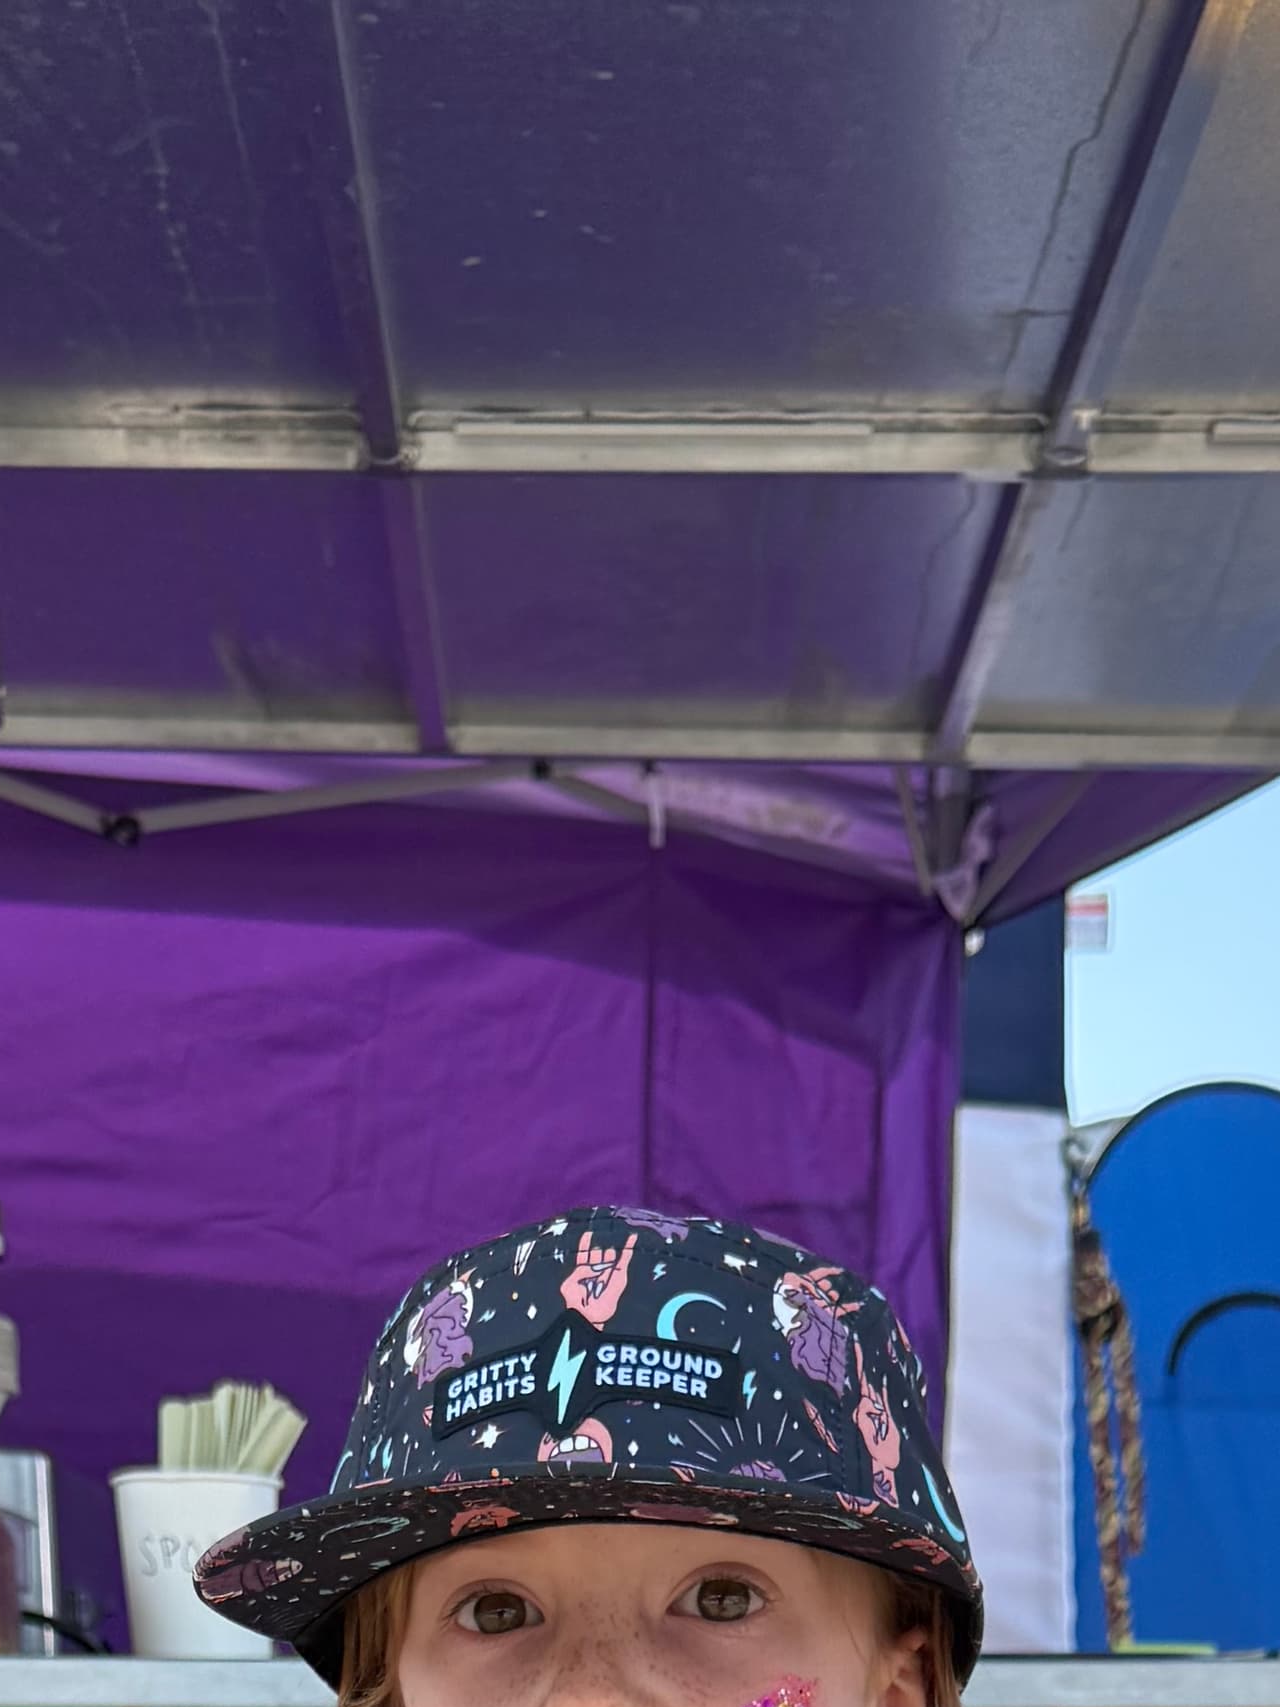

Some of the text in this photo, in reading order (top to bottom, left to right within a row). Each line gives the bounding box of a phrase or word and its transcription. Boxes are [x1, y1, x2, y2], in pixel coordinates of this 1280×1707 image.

[447, 1353, 537, 1399] GRITTY
[597, 1344, 723, 1380] GROUND
[445, 1375, 536, 1422] HABITS
[595, 1367, 708, 1399] KEEPER
